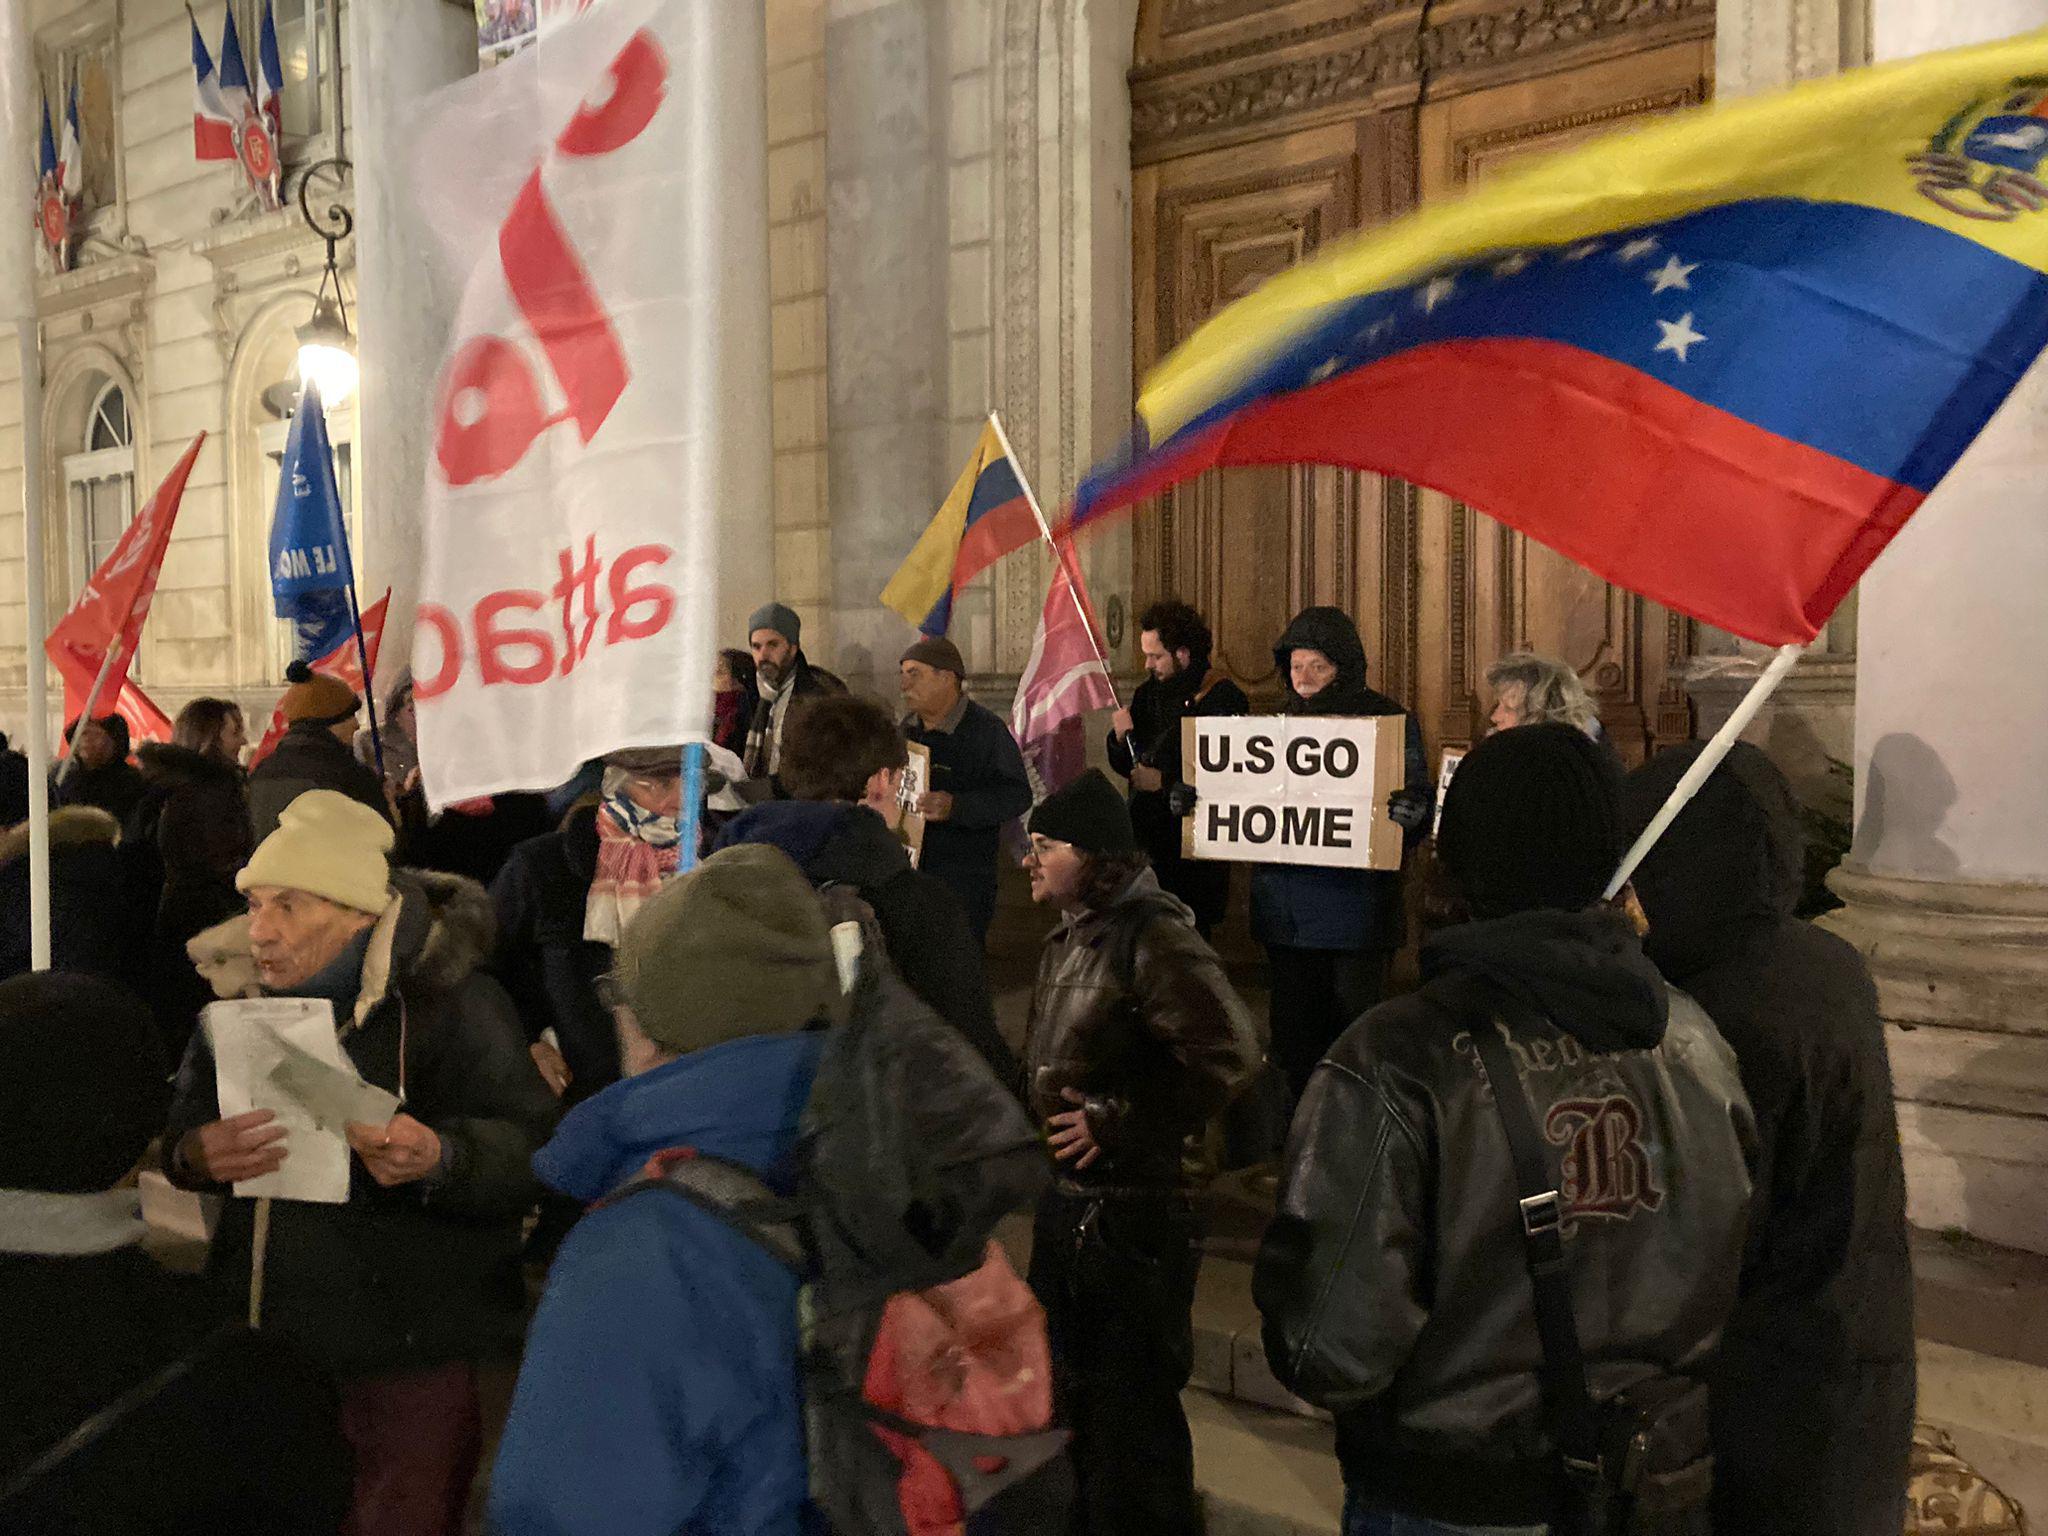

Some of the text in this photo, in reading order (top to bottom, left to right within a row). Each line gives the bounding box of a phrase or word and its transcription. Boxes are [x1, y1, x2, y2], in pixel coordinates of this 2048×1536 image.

[1199, 735, 1359, 778] U.S GO
[1207, 804, 1354, 848] HOME
